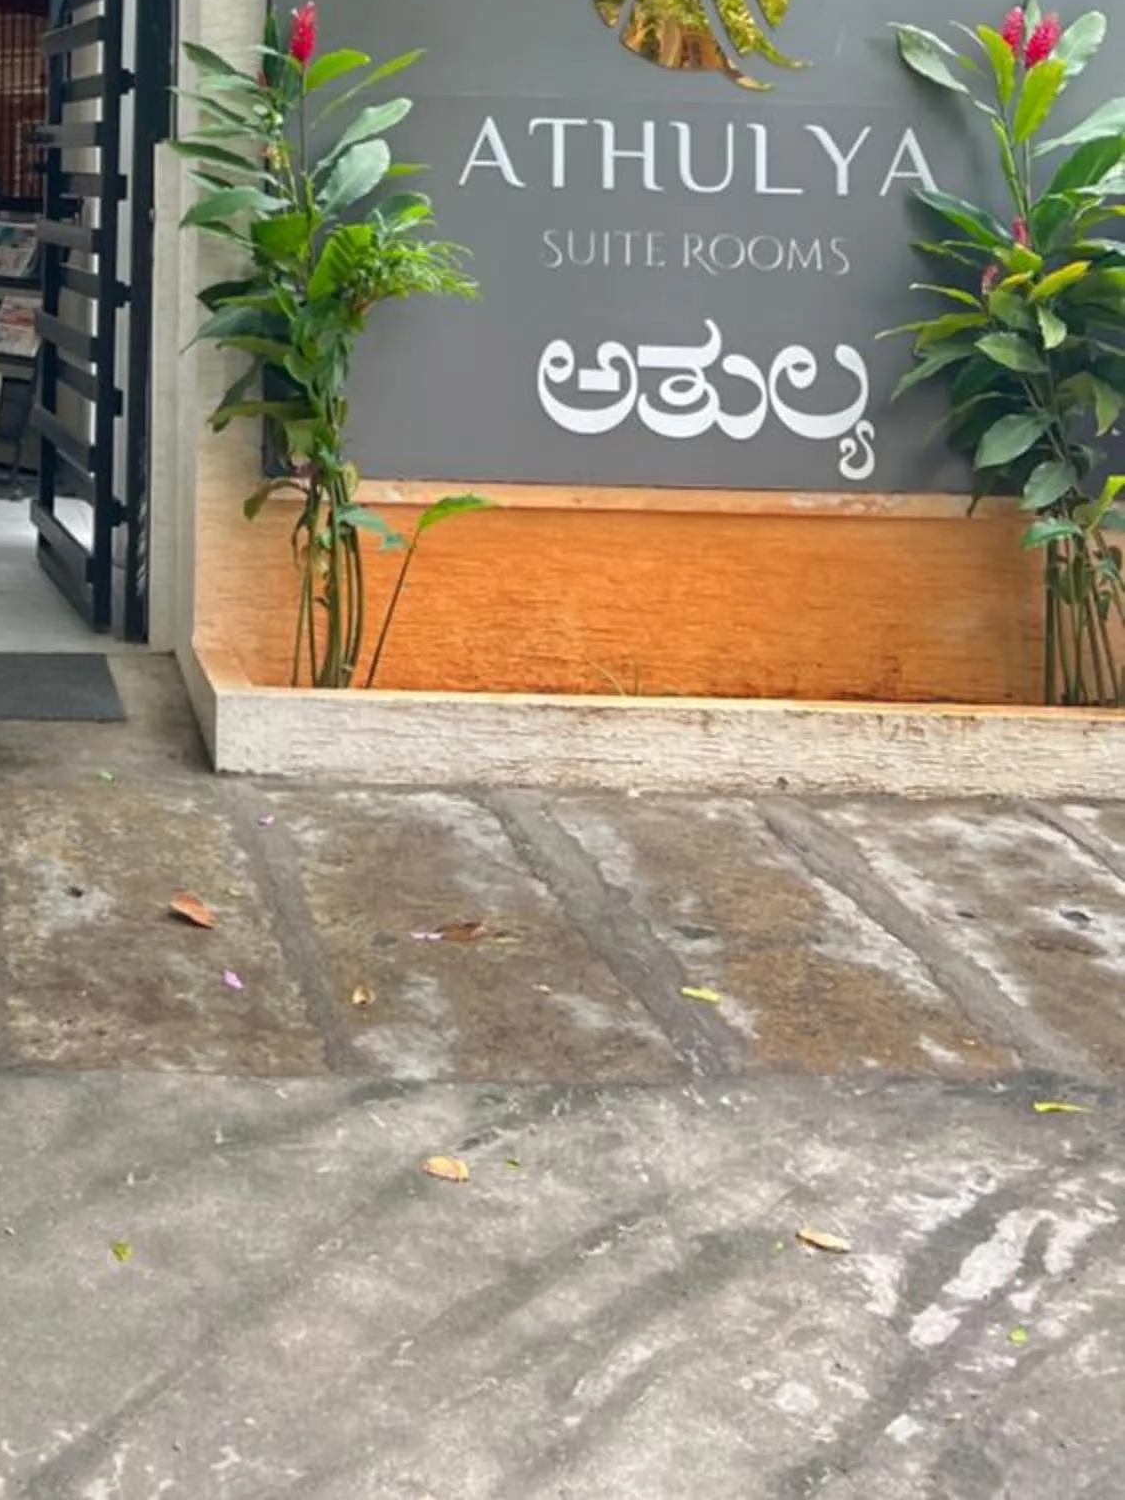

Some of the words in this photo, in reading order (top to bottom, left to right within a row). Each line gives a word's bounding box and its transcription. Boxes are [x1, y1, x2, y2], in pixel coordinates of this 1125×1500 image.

[459, 116, 941, 197] ATHULYA
[541, 229, 665, 269] SUITE
[682, 232, 851, 276] ROOMS
[537, 318, 875, 480] ಅತುಲ್ಯ
